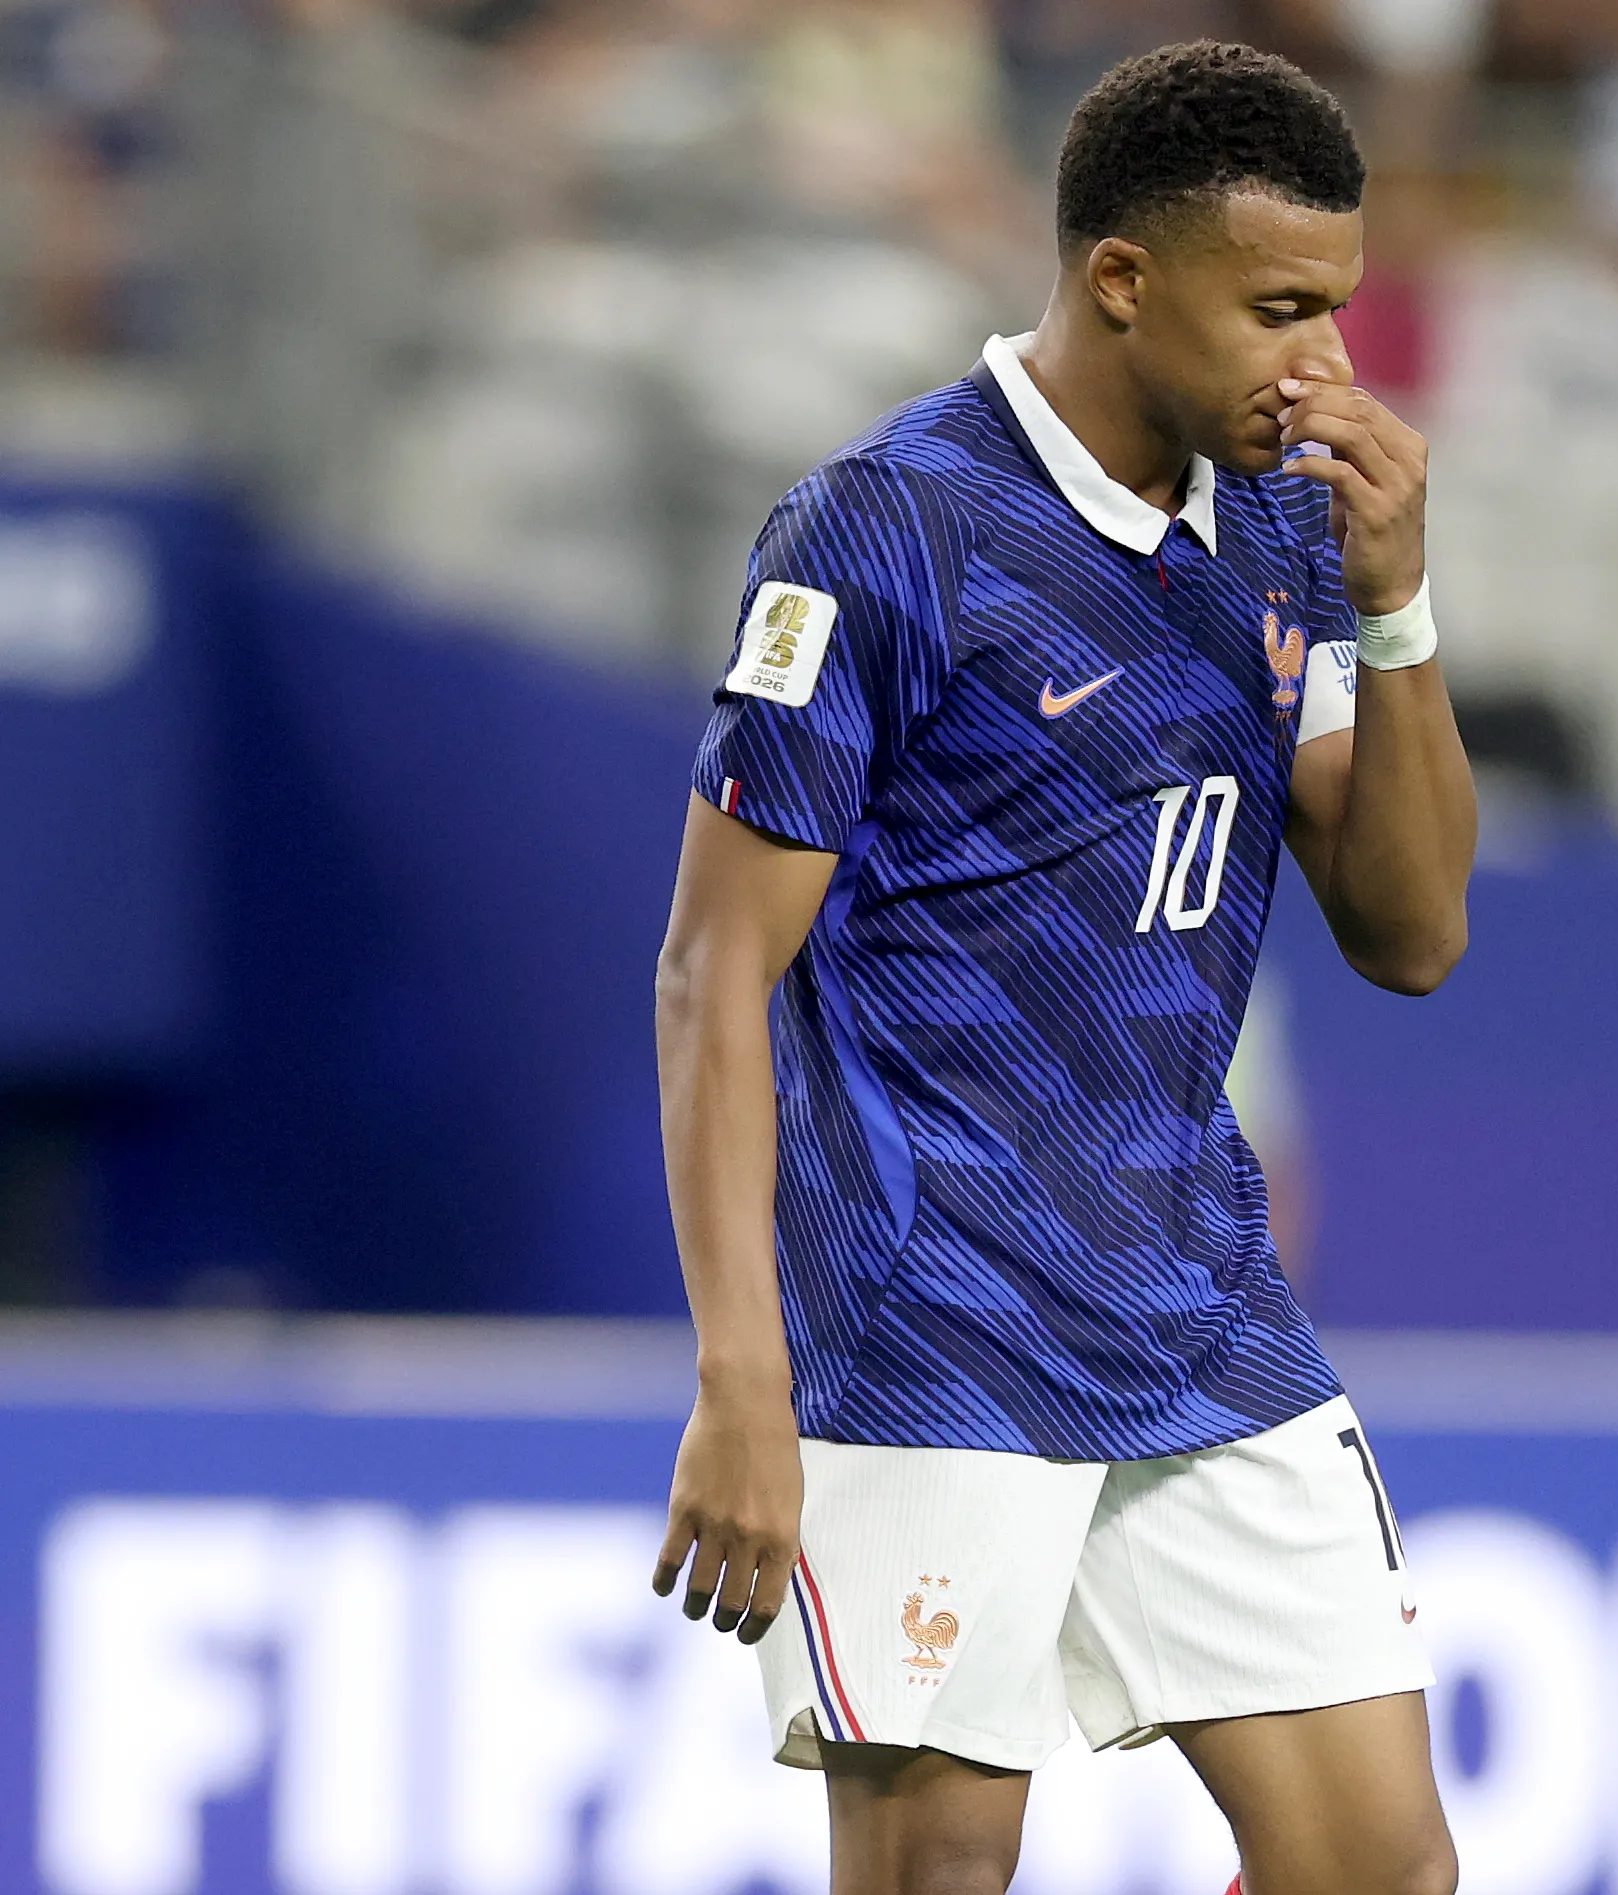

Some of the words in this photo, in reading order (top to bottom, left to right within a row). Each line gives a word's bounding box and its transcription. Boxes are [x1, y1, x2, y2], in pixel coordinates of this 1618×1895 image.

[771, 671, 789, 681] CUP
[1135, 775, 1240, 933] 10
[1337, 1427, 1407, 1571] 1
